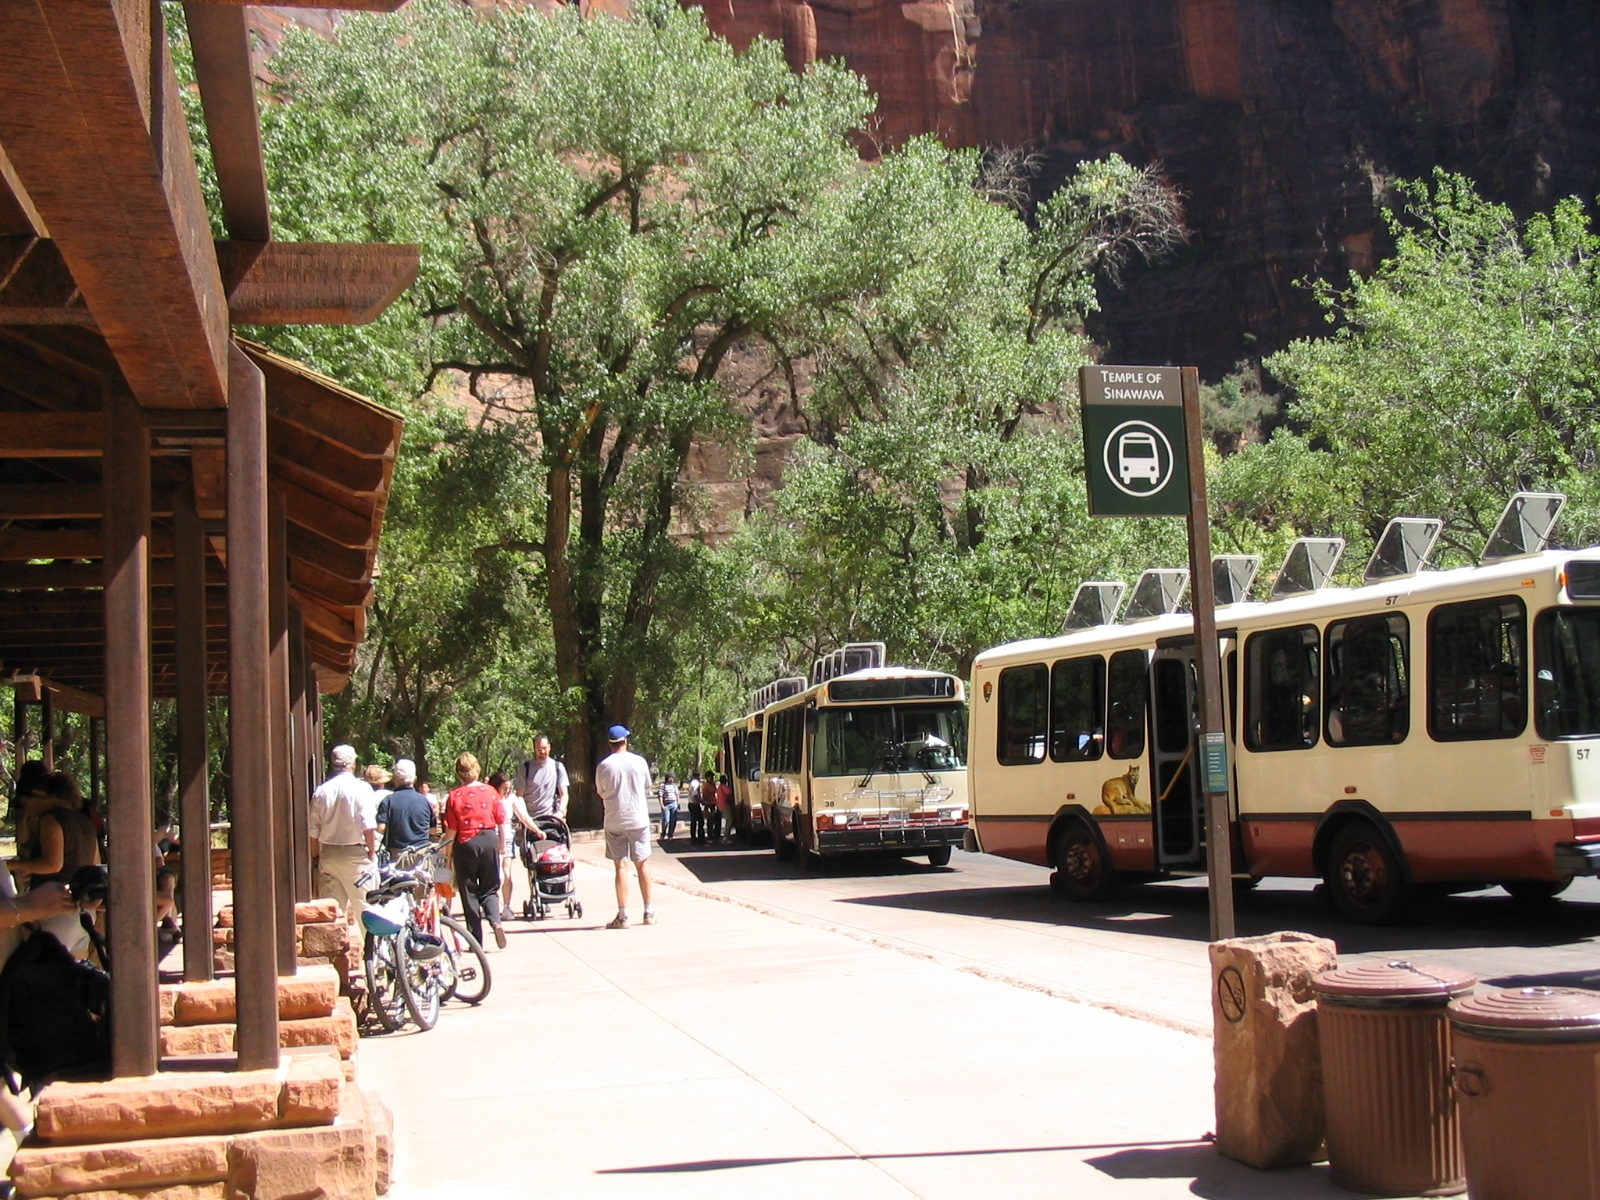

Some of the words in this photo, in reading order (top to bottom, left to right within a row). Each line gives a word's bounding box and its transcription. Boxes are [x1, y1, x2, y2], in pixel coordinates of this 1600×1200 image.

[1100, 370, 1144, 384] TEMPLE
[1146, 372, 1162, 384] OF
[1104, 386, 1165, 400] SINAWAVA
[1385, 595, 1399, 606] 57
[1576, 748, 1590, 760] 57
[824, 800, 835, 808] 38
